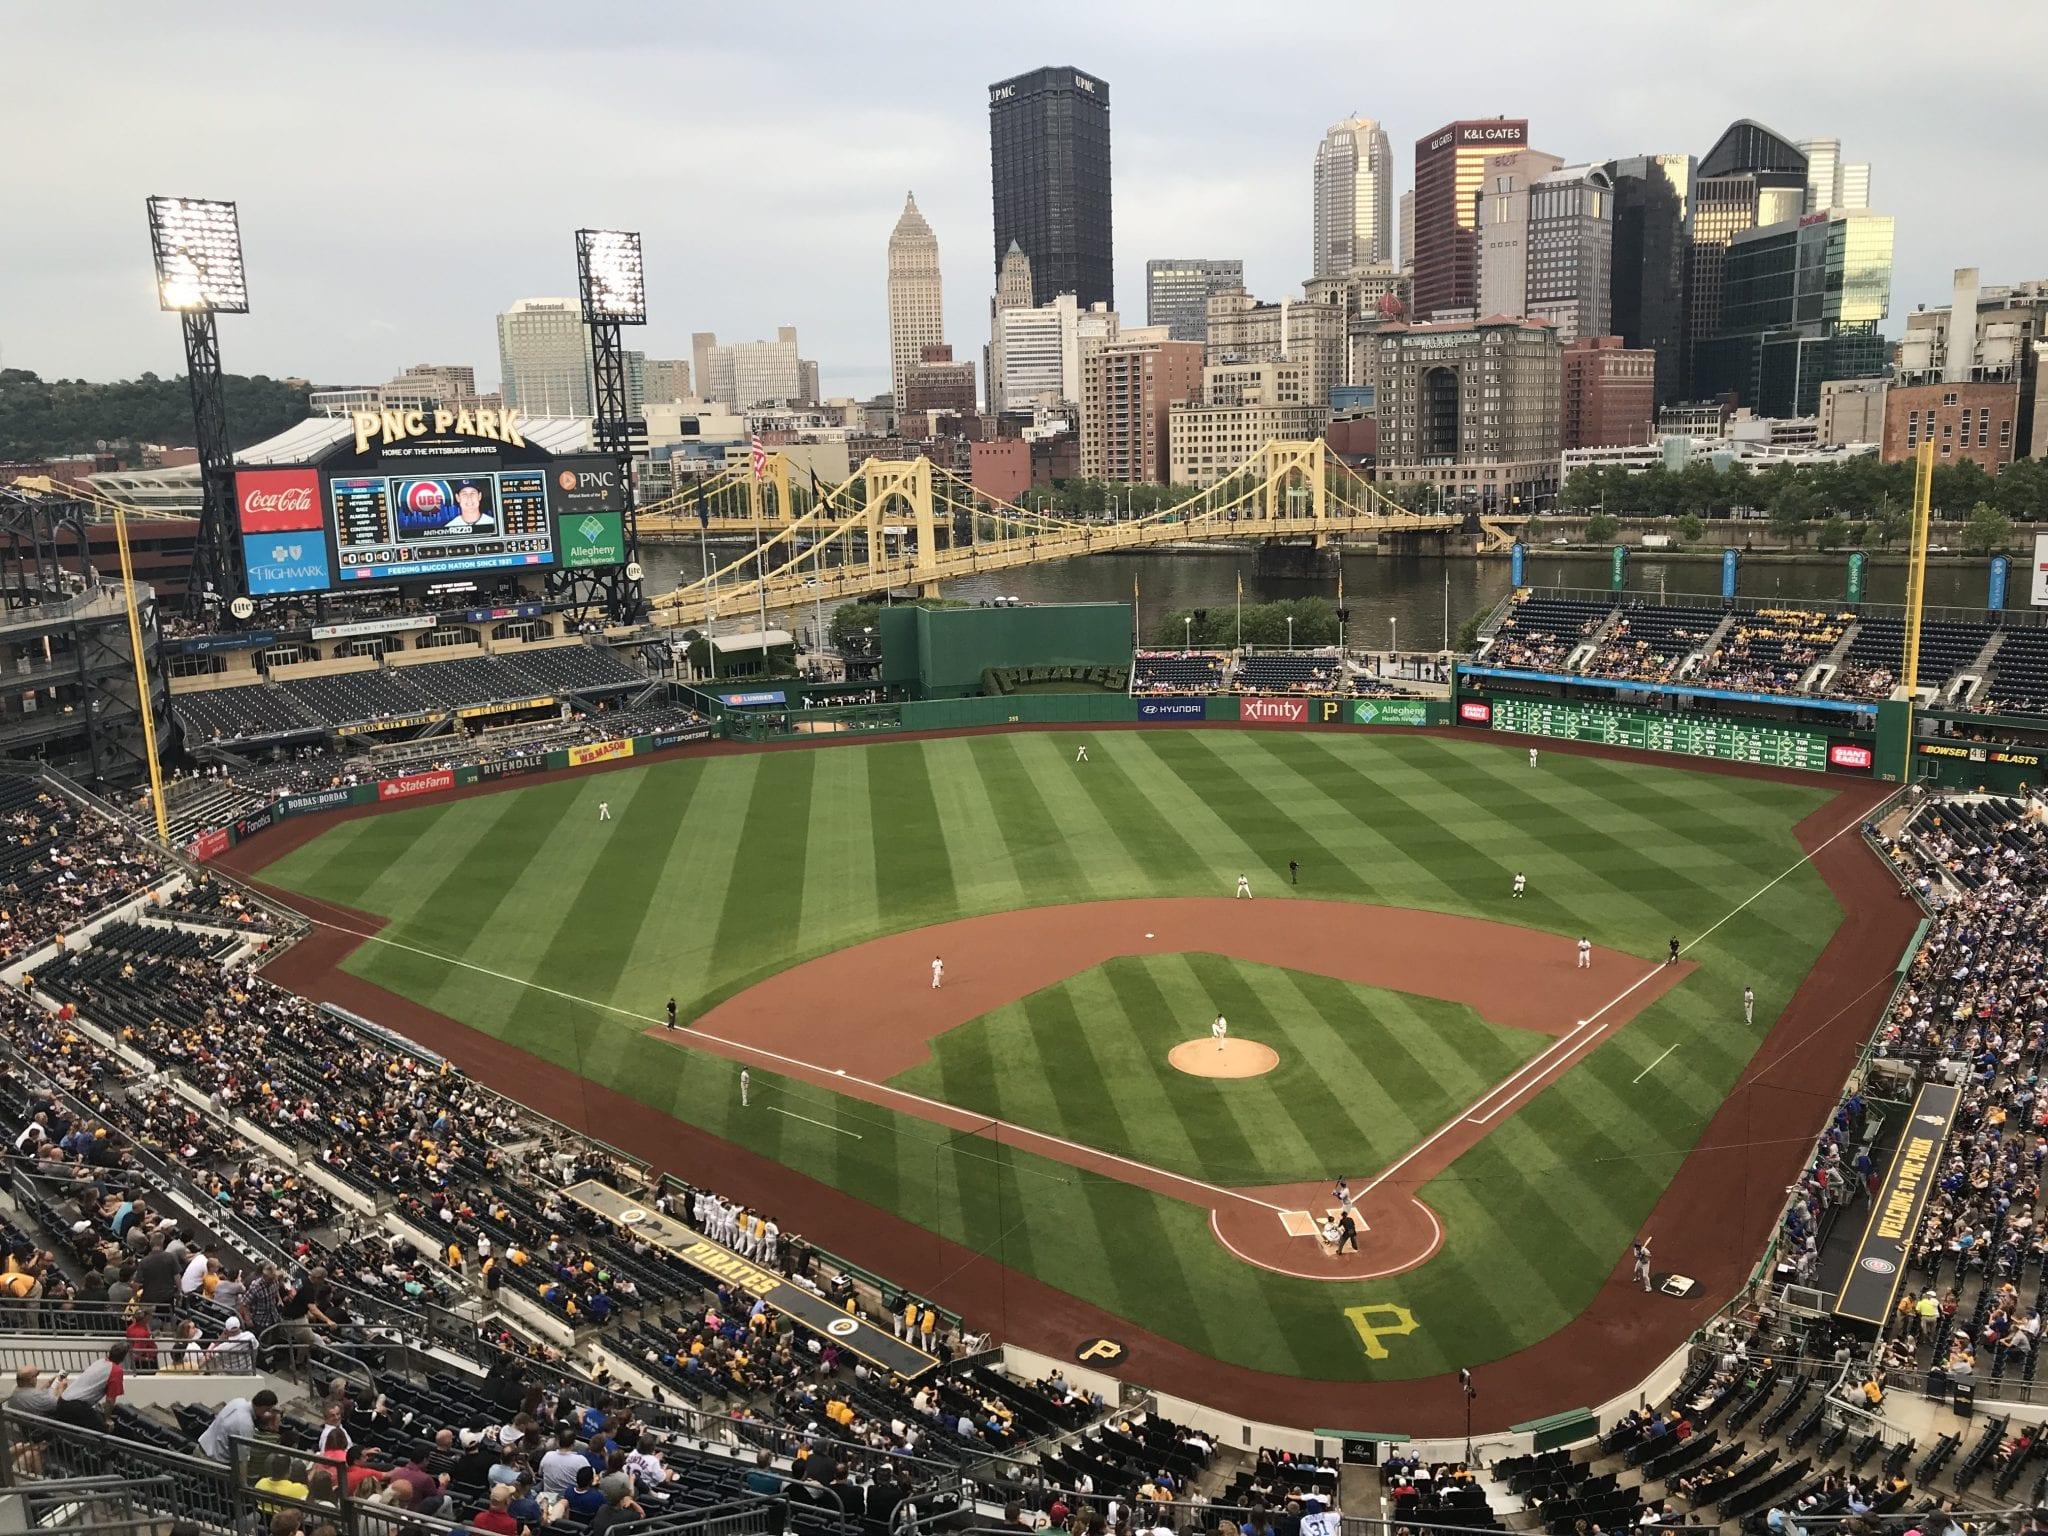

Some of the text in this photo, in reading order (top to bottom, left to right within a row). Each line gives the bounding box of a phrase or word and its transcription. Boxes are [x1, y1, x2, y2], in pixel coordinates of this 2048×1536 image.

[990, 84, 1016, 103] UPMC
[1075, 75, 1095, 94] UPMC
[1431, 131, 1453, 151] K&L GATES
[1464, 128, 1521, 140] K&L GATES
[525, 303, 565, 311] Federated
[352, 408, 526, 456] PNC PARK
[382, 449, 403, 457] HOME
[414, 448, 428, 456] THE
[428, 446, 470, 455] PITTSBURGH
[470, 446, 497, 454] PIRATES
[578, 471, 615, 488] PNC
[244, 488, 314, 514] Coca-Cola
[424, 525, 473, 537] ANTHONY RIZZO
[348, 553, 357, 564] 0
[365, 552, 373, 562] 0
[381, 551, 390, 561] 0
[570, 545, 616, 558] Allegheny
[249, 563, 325, 581] HIGHMARK
[387, 566, 420, 576] FEEDING
[421, 563, 447, 572] BUCCO
[448, 560, 476, 570] NATION
[477, 558, 497, 568] SINCE
[628, 567, 641, 577] Lite
[233, 601, 251, 615] Lite
[994, 666, 1130, 692] PIRATES
[743, 694, 774, 702] LUMBER
[1159, 705, 1201, 713] HYUNDAI
[1245, 700, 1303, 721] xfinity
[1323, 701, 1338, 721] P
[1381, 705, 1426, 716] Allegheny
[1506, 699, 1632, 719] NATIONAL LEAGUE
[355, 716, 431, 734] IRON CITY BEER
[1662, 717, 1811, 739] AMERICAN LEAGUE
[677, 730, 710, 743] SPORTSNET
[1835, 748, 1867, 758] GIANT
[1835, 754, 1866, 765] EAGLE
[1925, 745, 1969, 757] BOWSER
[1997, 753, 2039, 765] BLASTS
[483, 755, 543, 775] RIVENDALE
[287, 796, 317, 810] BORDAS
[319, 790, 348, 804] BORDAS
[247, 812, 271, 834] Fanatics
[1906, 1136, 1935, 1163] PARK
[1899, 1159, 1925, 1182] PNC
[1877, 1188, 1917, 1239] WELCOME
[682, 1241, 782, 1295] PIRATES
[1344, 1302, 1421, 1360] P
[1078, 1338, 1122, 1361] P
